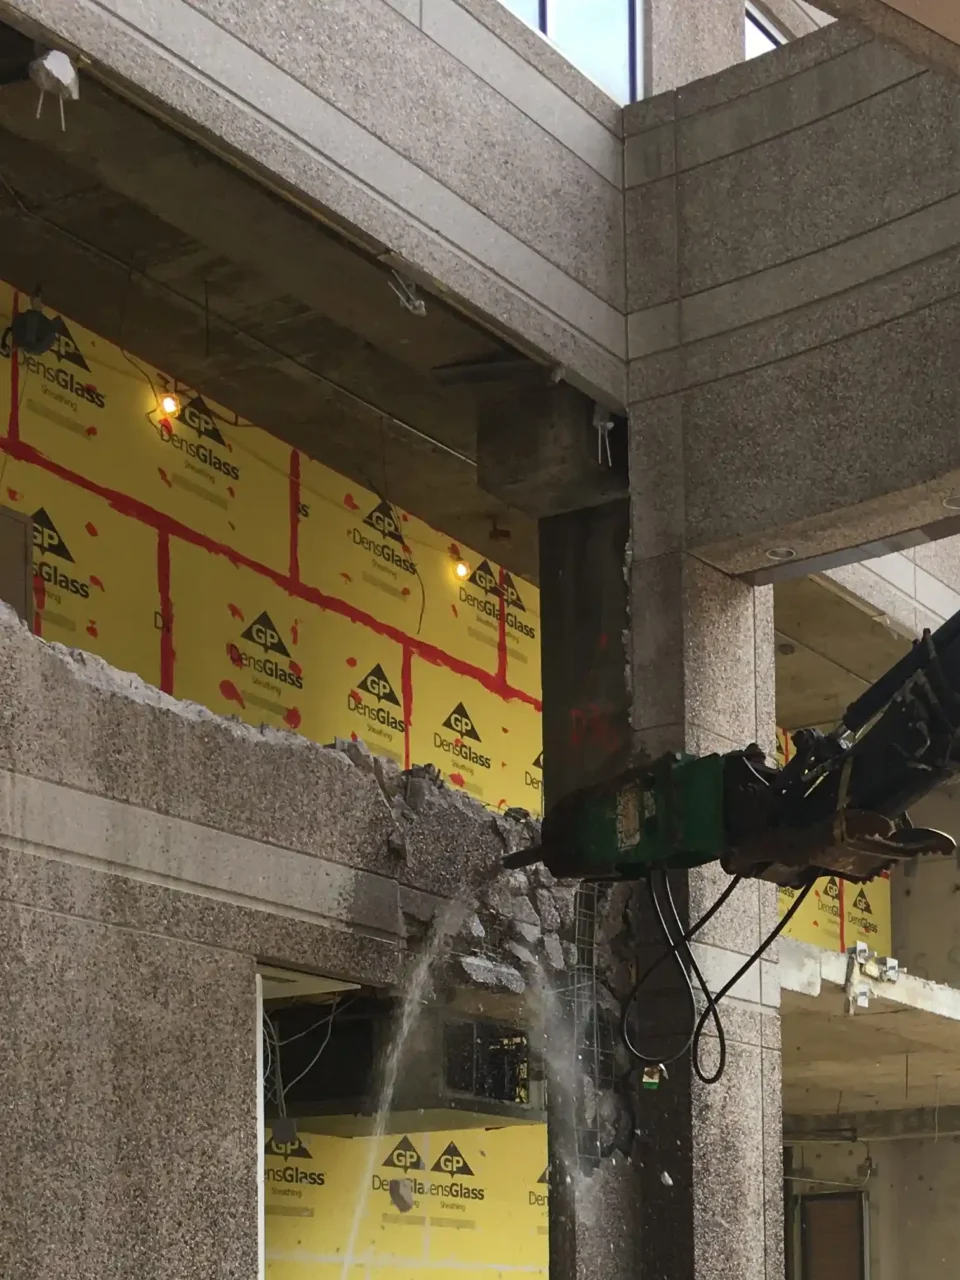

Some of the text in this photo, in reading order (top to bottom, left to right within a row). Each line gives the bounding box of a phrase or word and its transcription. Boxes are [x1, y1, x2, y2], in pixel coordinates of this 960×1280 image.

[184, 407, 214, 432] GP
[161, 421, 239, 480] DensGlass
[371, 511, 396, 534] GP
[352, 528, 416, 575] DensGlass
[32, 561, 90, 599] sGlass
[475, 570, 496, 589] GP
[459, 586, 501, 621] DensGla
[251, 624, 279, 647] GP
[229, 643, 304, 690] DensGlass
[366, 675, 391, 697] GP
[347, 692, 406, 733] DensGlas
[450, 713, 472, 734] GP
[433, 731, 492, 770] DensGlass
[392, 1149, 418, 1168] GP
[439, 1155, 464, 1172] GP
[264, 1166, 325, 1186] nsGlass
[429, 1182, 485, 1201] ensGlass
